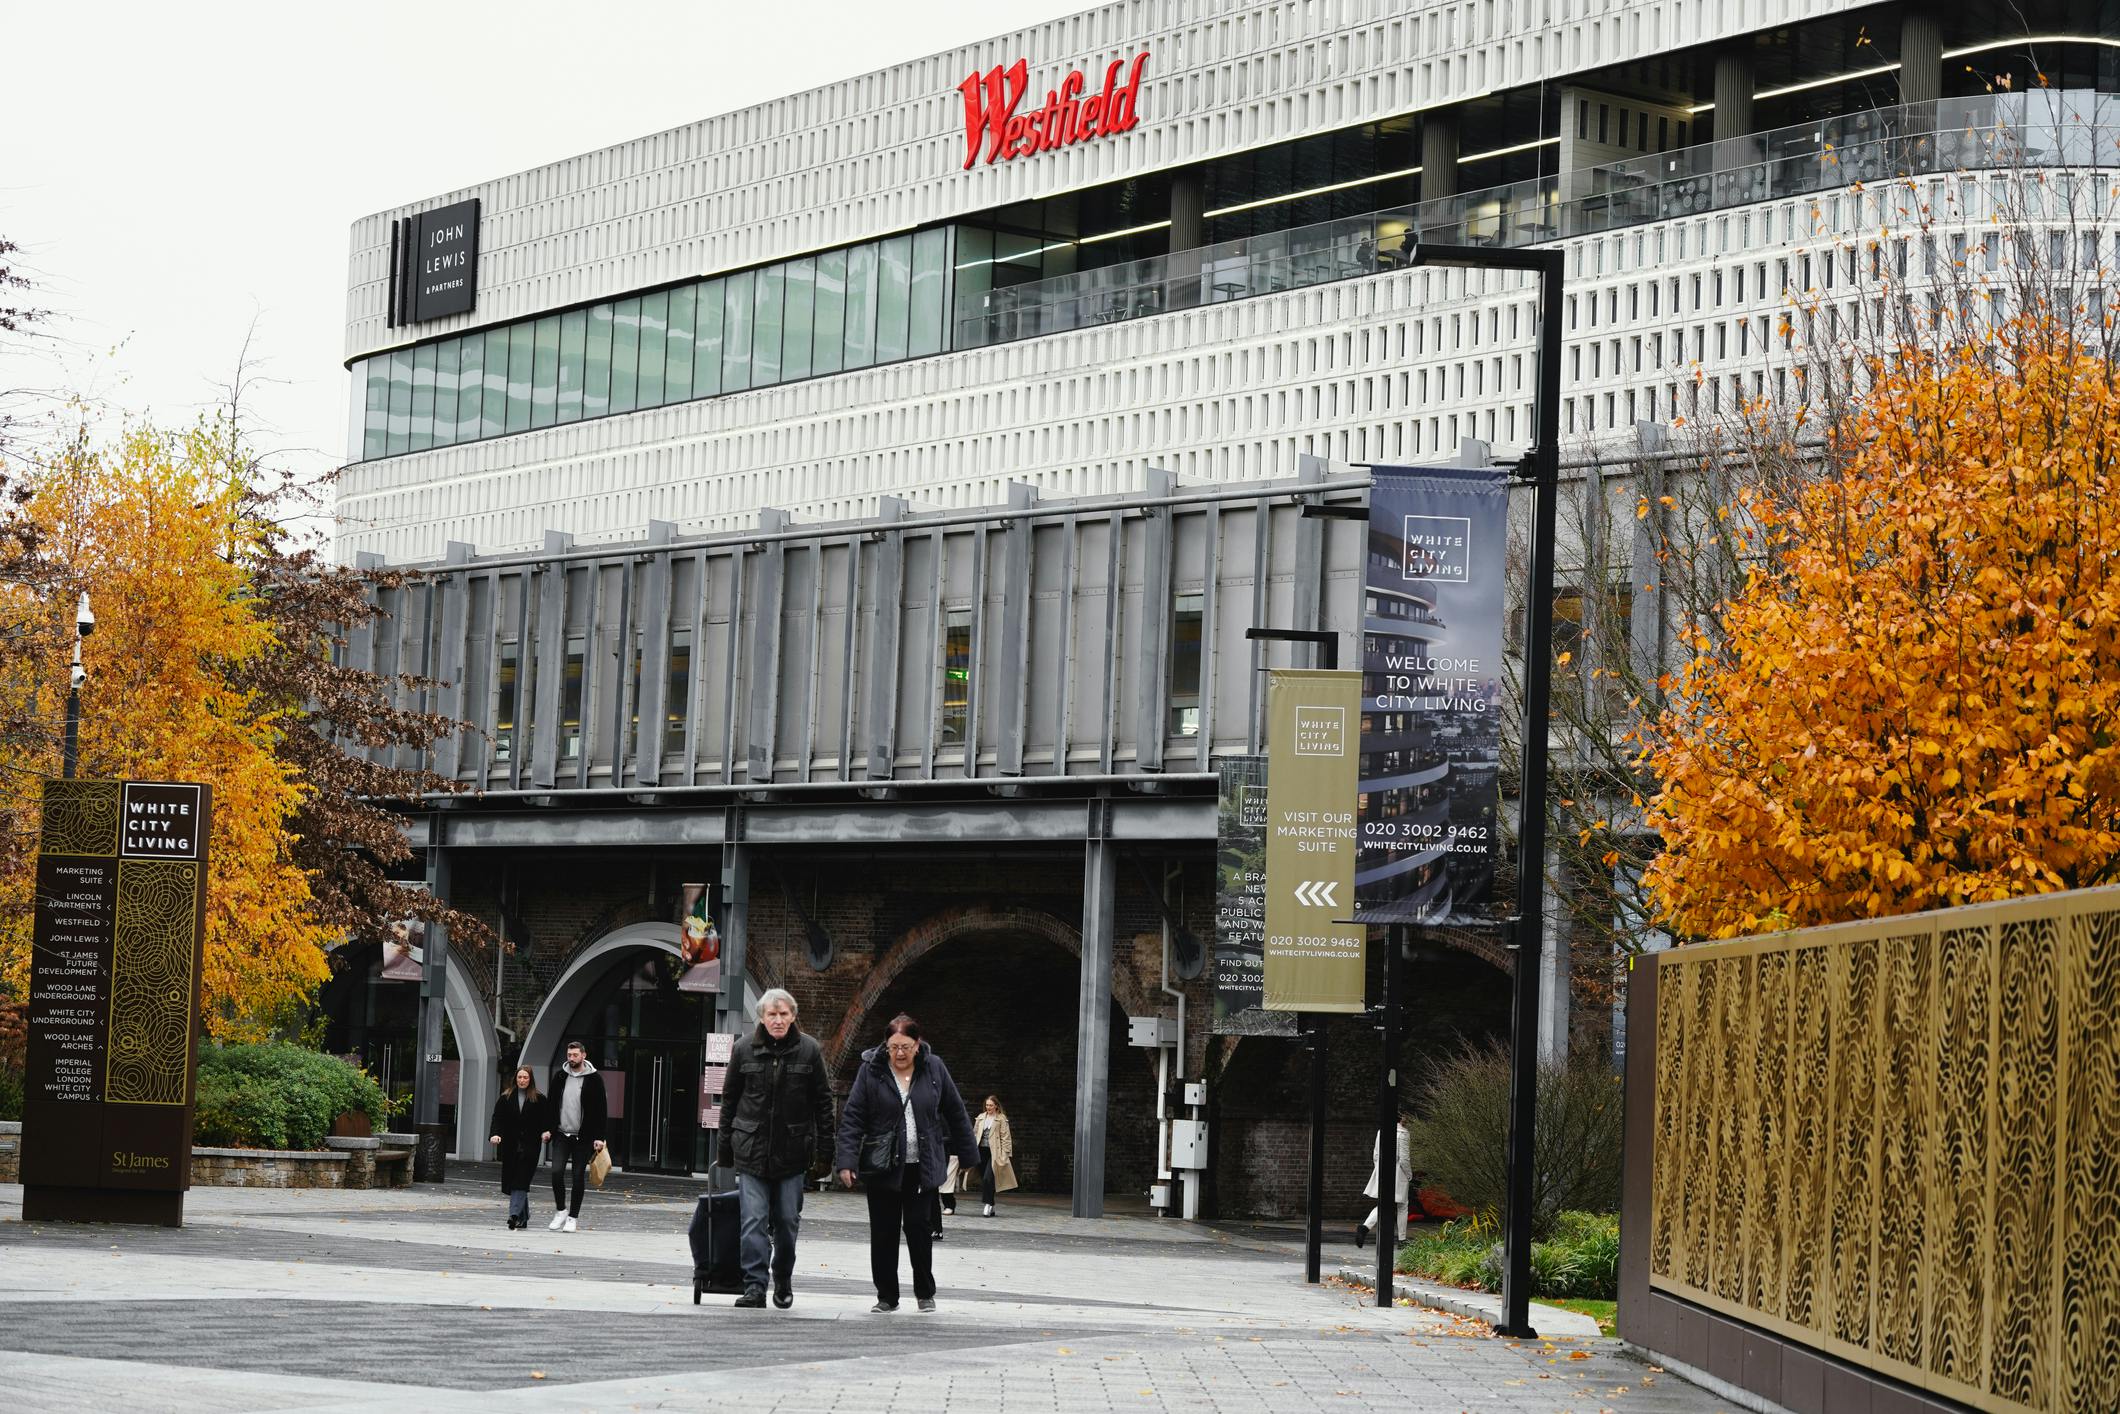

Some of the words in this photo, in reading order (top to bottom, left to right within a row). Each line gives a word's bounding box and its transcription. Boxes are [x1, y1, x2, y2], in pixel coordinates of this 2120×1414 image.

[957, 52, 1150, 170] Westfield
[431, 224, 464, 248] JOHN
[427, 251, 465, 274] LEWIS
[426, 286, 430, 295] &
[432, 278, 463, 293] PARTNERS
[1410, 534, 1462, 547] WHITE
[1410, 549, 1446, 560] CITY
[1409, 563, 1462, 575] LIVING
[1386, 656, 1479, 672] WELCOME
[1386, 675, 1410, 690] TO
[1417, 676, 1477, 692] WHITE
[1376, 694, 1417, 710] CITY
[1424, 696, 1486, 712] LIVING
[1300, 720, 1340, 729] WHITE
[1300, 731, 1327, 740] CITY
[1300, 742, 1340, 751] LIVING
[130, 802, 189, 815] WHITE
[1284, 811, 1319, 823] VISIT
[1323, 812, 1352, 824] OUR
[129, 820, 170, 831] CITY
[1365, 822, 1394, 836] 020
[1401, 823, 1442, 838] 3002
[1447, 825, 1487, 840] 9462
[1277, 826, 1357, 838] MARKETING
[128, 837, 189, 849] LIVING
[1297, 841, 1337, 853] SUITE
[1363, 841, 1487, 854] WHITECITYLIVING.CO.UK
[56, 867, 103, 875] MARKETING
[48, 902, 101, 910] APARTMENTS
[1238, 897, 1244, 905] 5
[1248, 897, 1266, 905] AC
[1221, 908, 1261, 917] PUBLIC
[55, 918, 100, 926] WESTFIELD
[1224, 920, 1248, 929] AND
[1270, 936, 1292, 946] 020
[1296, 937, 1327, 947] 3002
[1330, 938, 1360, 948] 9462
[1269, 950, 1360, 959] WHITECITYLIVING.CO.UK
[39, 968, 97, 976] DEVELOPMENT
[33, 1017, 94, 1025] UNDERGROUND
[710, 1035, 730, 1043] WOOD
[712, 1044, 728, 1052] LANE
[55, 1067, 92, 1075] COLLEGE
[57, 1093, 90, 1101] CAMPUS
[113, 1151, 126, 1166] St
[129, 1152, 169, 1168] James
